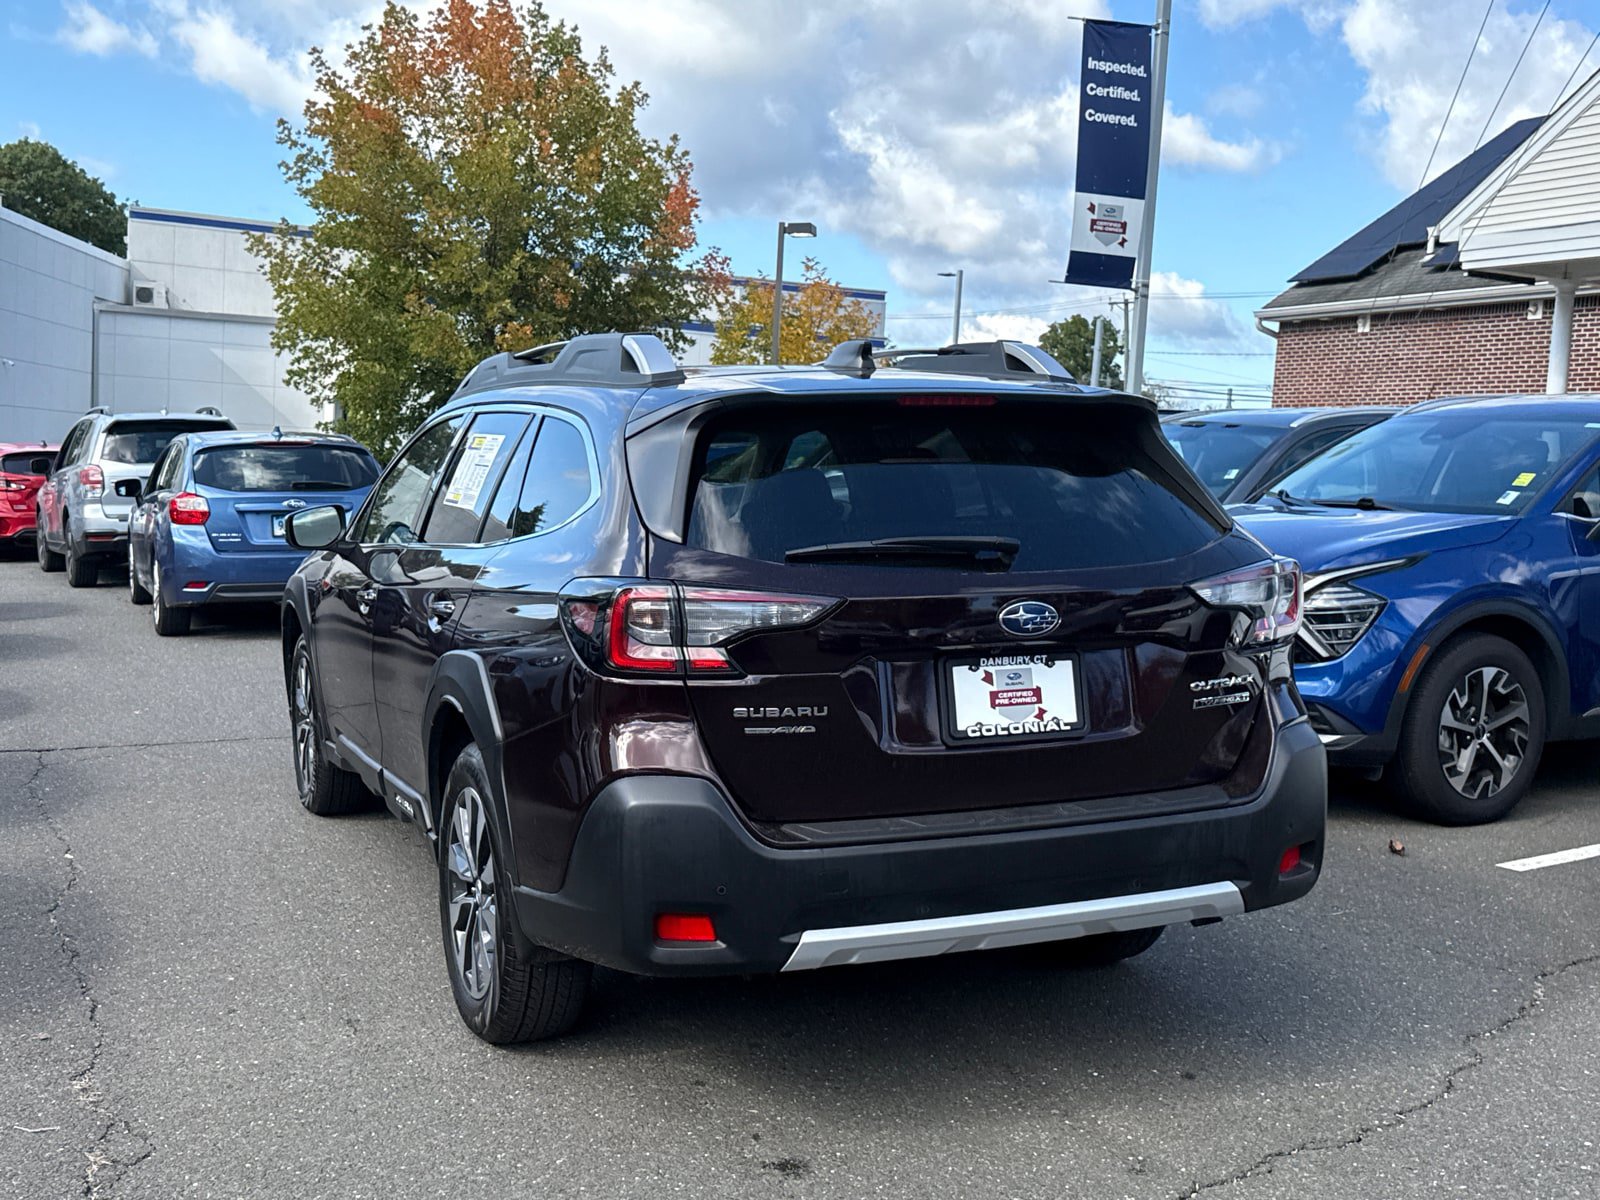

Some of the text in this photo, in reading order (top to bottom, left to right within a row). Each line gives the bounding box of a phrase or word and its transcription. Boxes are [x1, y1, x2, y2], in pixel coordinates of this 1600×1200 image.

[1087, 57, 1147, 77] Inspected.
[1086, 83, 1141, 101] Certified.
[1085, 109, 1138, 127] Covered.
[1034, 655, 1048, 664] CT
[995, 696, 1038, 705] PRE-OWNED
[998, 690, 1034, 699] CERTIFIED
[733, 705, 828, 718] SUBARU
[966, 719, 1071, 738] COLONIAL
